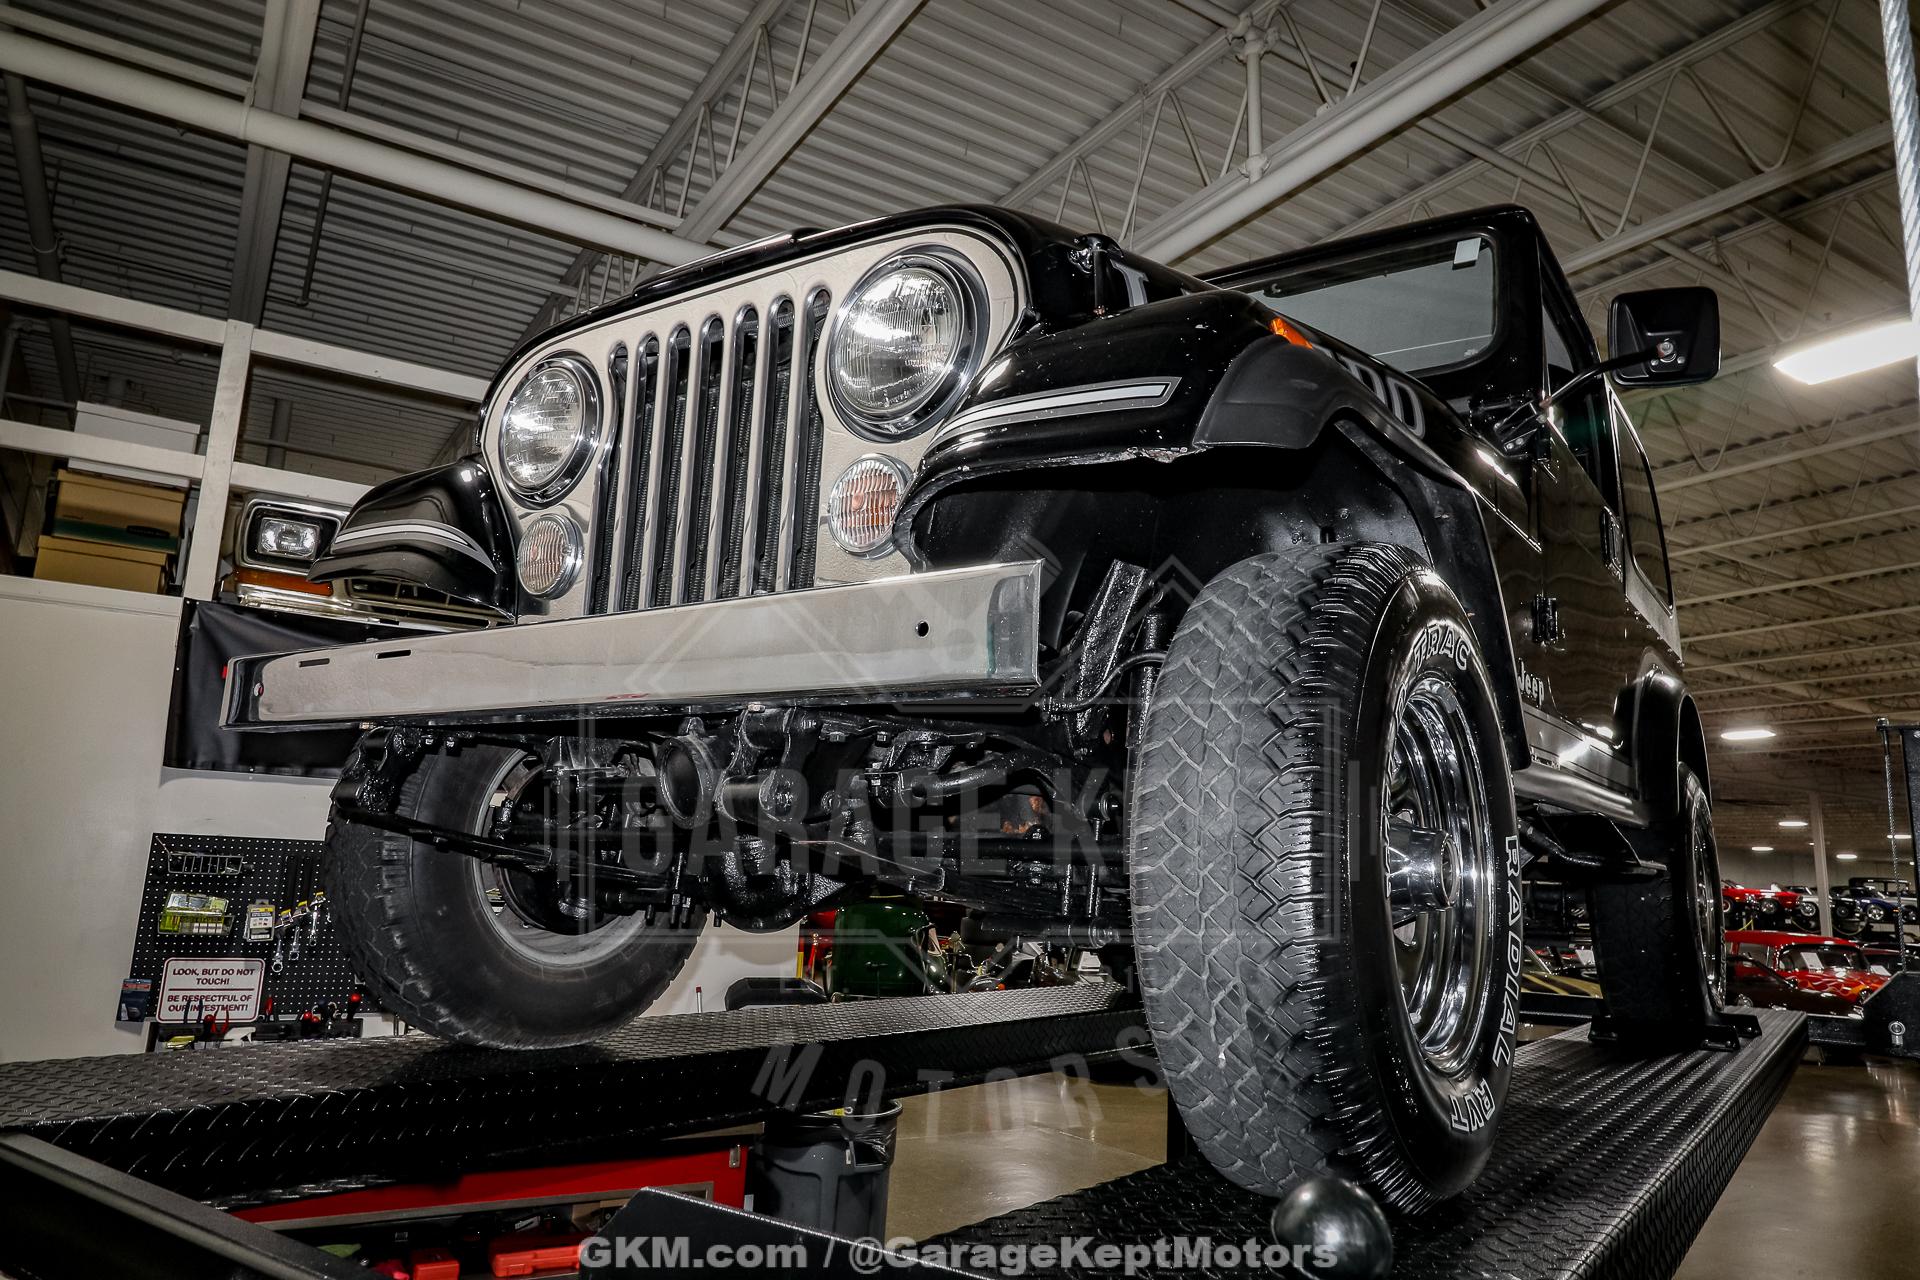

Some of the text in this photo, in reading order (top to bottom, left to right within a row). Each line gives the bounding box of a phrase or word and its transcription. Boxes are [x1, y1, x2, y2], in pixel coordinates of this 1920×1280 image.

[1413, 625, 1471, 673] TRAC
[1517, 660, 1545, 706] Jeep
[173, 968, 256, 976] LOOK, BUT DO NOT
[1449, 835, 1522, 1132] RADIAL RVT
[181, 994, 239, 1002] RESPECTFUL
[240, 994, 253, 1002] OF
